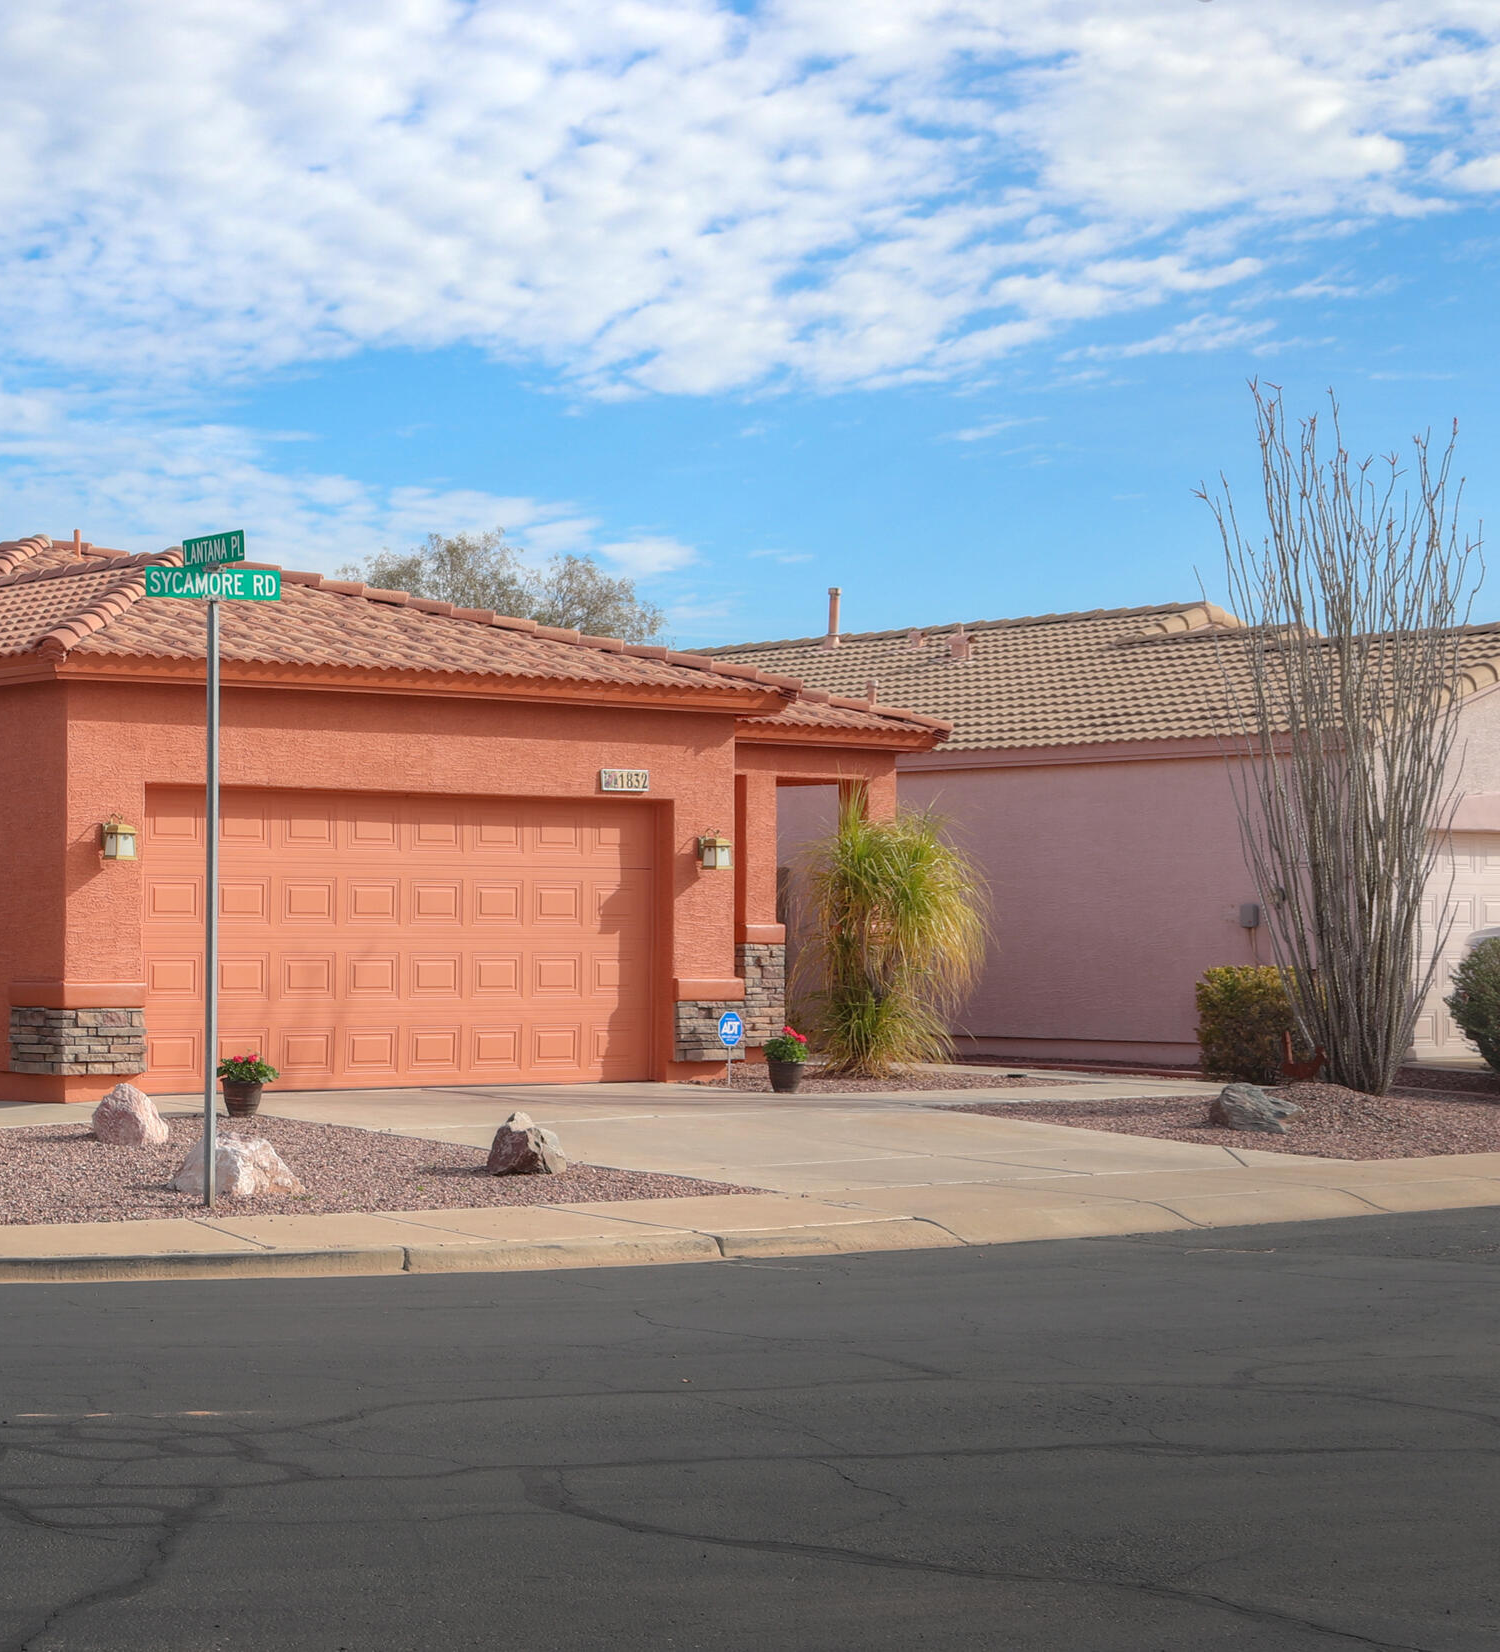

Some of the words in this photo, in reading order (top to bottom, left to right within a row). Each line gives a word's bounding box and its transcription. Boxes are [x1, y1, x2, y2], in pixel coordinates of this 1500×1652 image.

[184, 537, 227, 565] LANTANA
[231, 535, 244, 558] PL
[150, 571, 244, 596] SYCAMORE
[253, 574, 276, 596] RD
[619, 772, 648, 789] 1832
[721, 1021, 740, 1034] ADT
